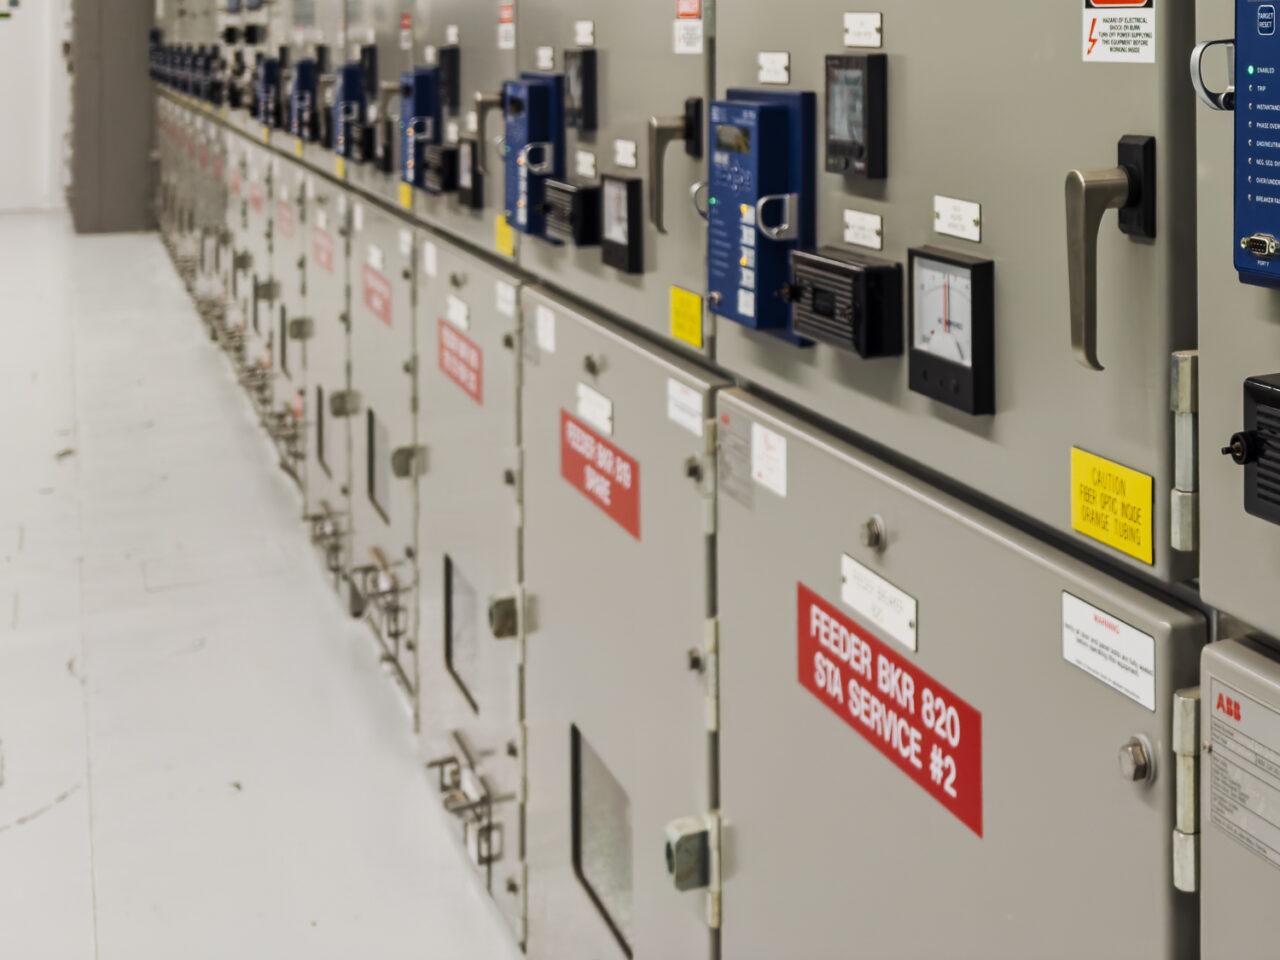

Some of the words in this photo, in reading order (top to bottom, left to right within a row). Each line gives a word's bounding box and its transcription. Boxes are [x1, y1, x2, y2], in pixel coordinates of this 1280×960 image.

[810, 603, 872, 680] FEEDER
[877, 652, 915, 714] BKR
[922, 686, 960, 748] 820
[814, 651, 844, 704] STA
[848, 678, 922, 769] SERVICE
[930, 742, 957, 798] #2
[1217, 692, 1241, 721] ABB
